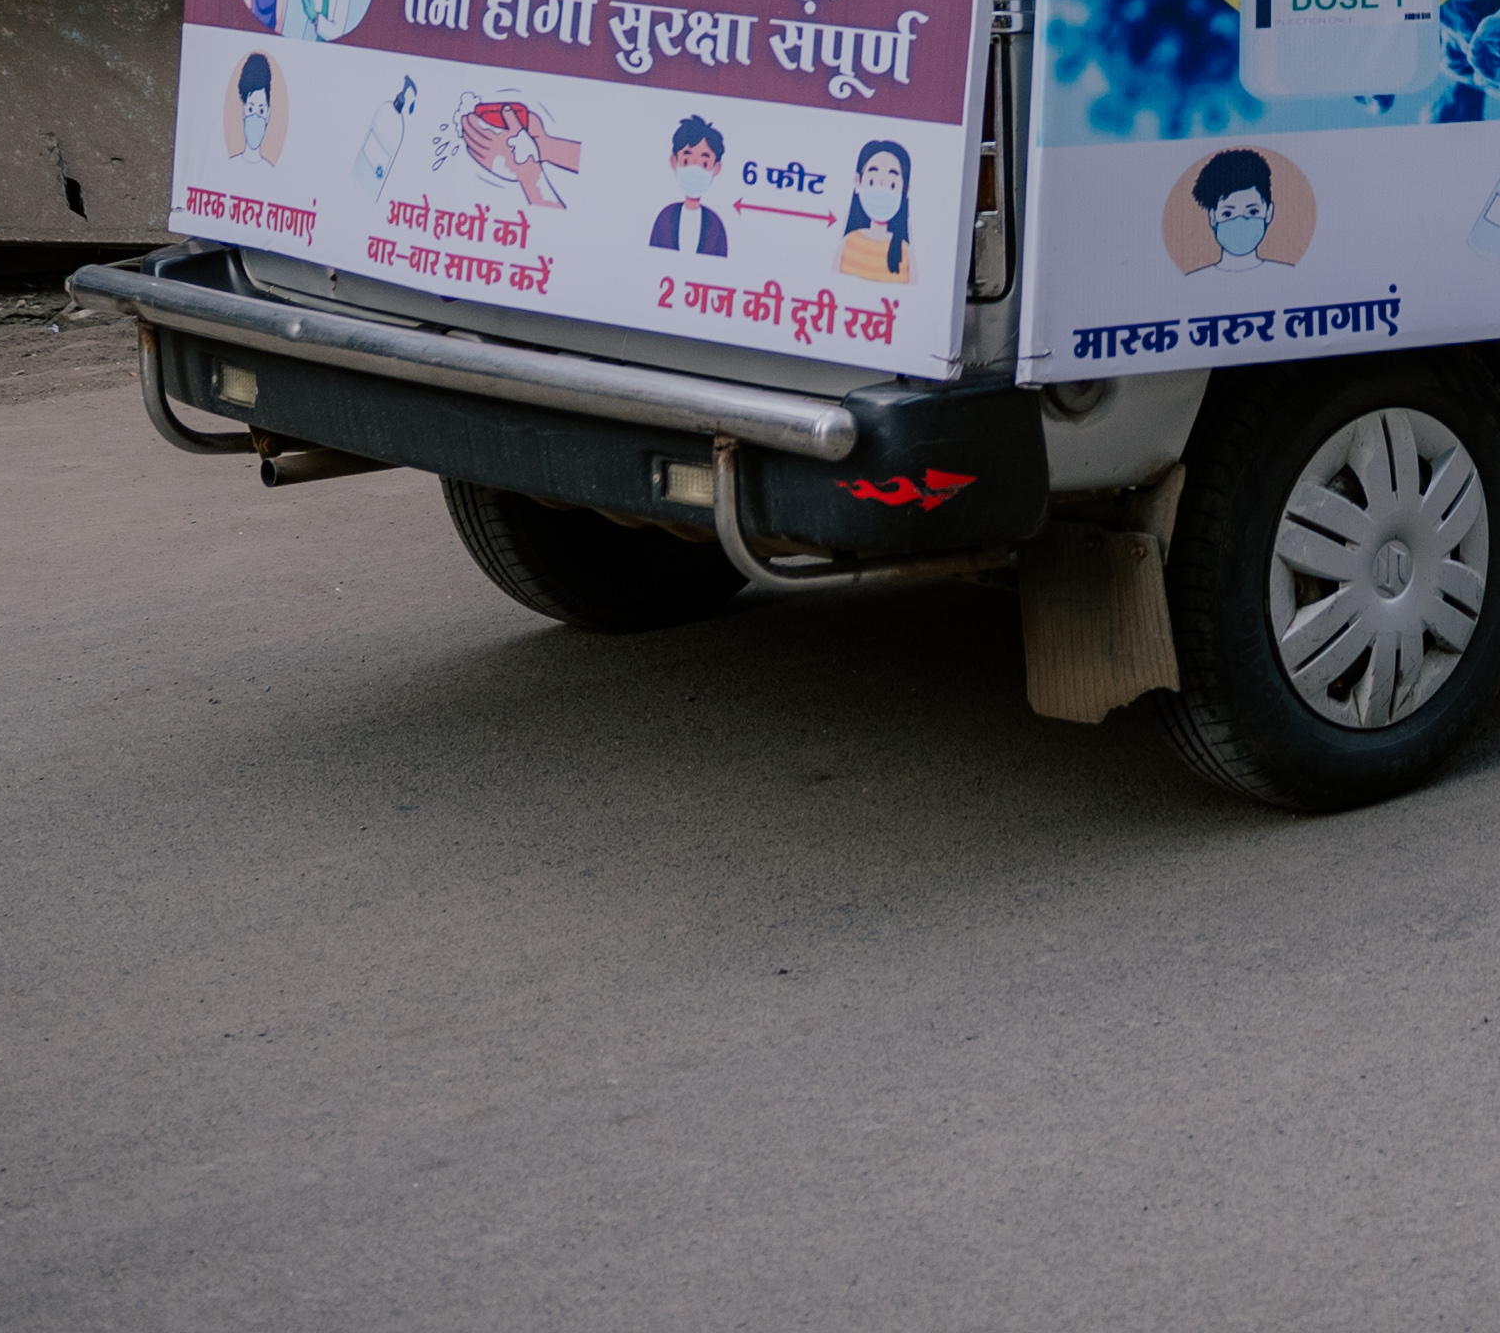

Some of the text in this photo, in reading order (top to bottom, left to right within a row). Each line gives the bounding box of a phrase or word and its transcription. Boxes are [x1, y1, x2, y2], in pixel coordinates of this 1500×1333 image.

[608, 1, 758, 74] सुरक्षा
[769, 0, 929, 99] संपूर्ण
[743, 161, 826, 195] 6 फीट
[187, 186, 226, 219] मास्क
[387, 194, 530, 249] अपने हाथों को
[444, 252, 553, 295] साफ करें
[658, 276, 899, 345] 2 गज की दूरी रखें
[1073, 319, 1180, 360] मास्क
